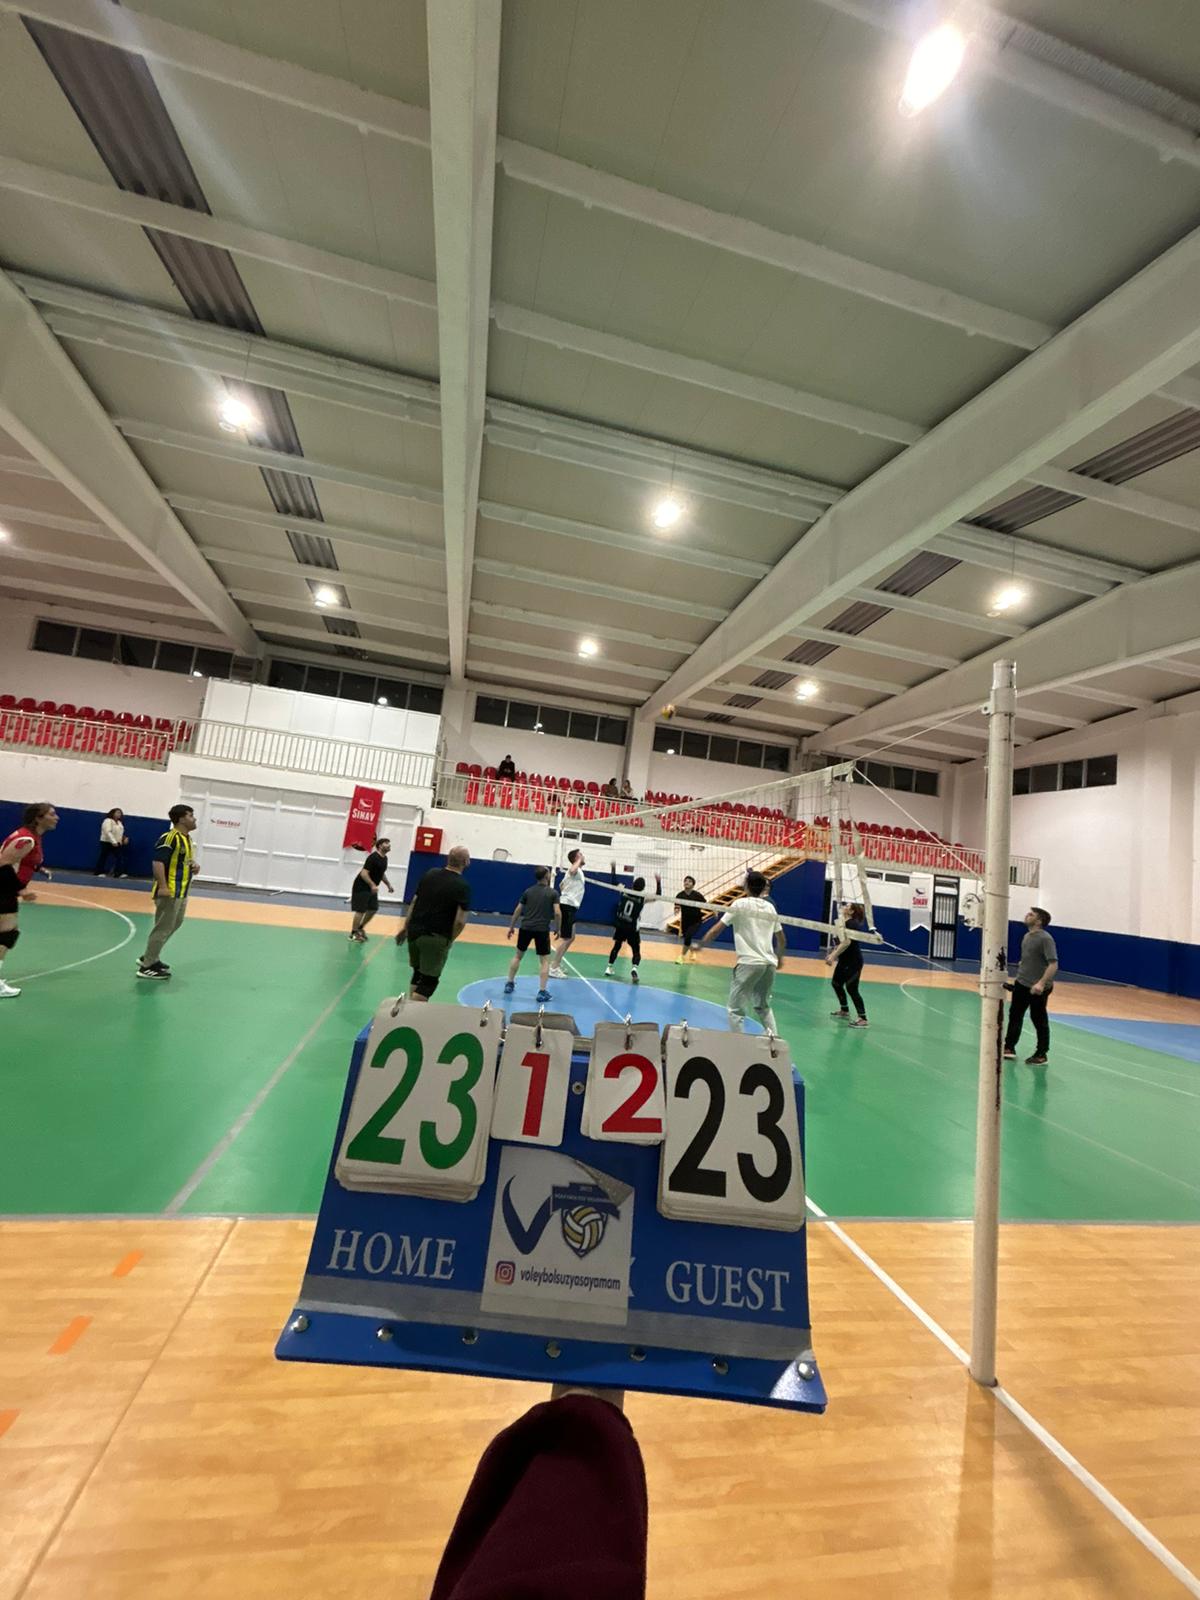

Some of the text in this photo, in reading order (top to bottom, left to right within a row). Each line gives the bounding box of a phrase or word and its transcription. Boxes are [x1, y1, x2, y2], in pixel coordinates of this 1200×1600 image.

[345, 1025, 485, 1170] 23
[521, 1052, 551, 1137] 1
[601, 1053, 663, 1134] 2
[668, 1056, 793, 1203] 23
[326, 1229, 456, 1281] HOME
[520, 1265, 621, 1292] voleybolsuzyasayamam
[664, 1260, 791, 1312] GUEST
